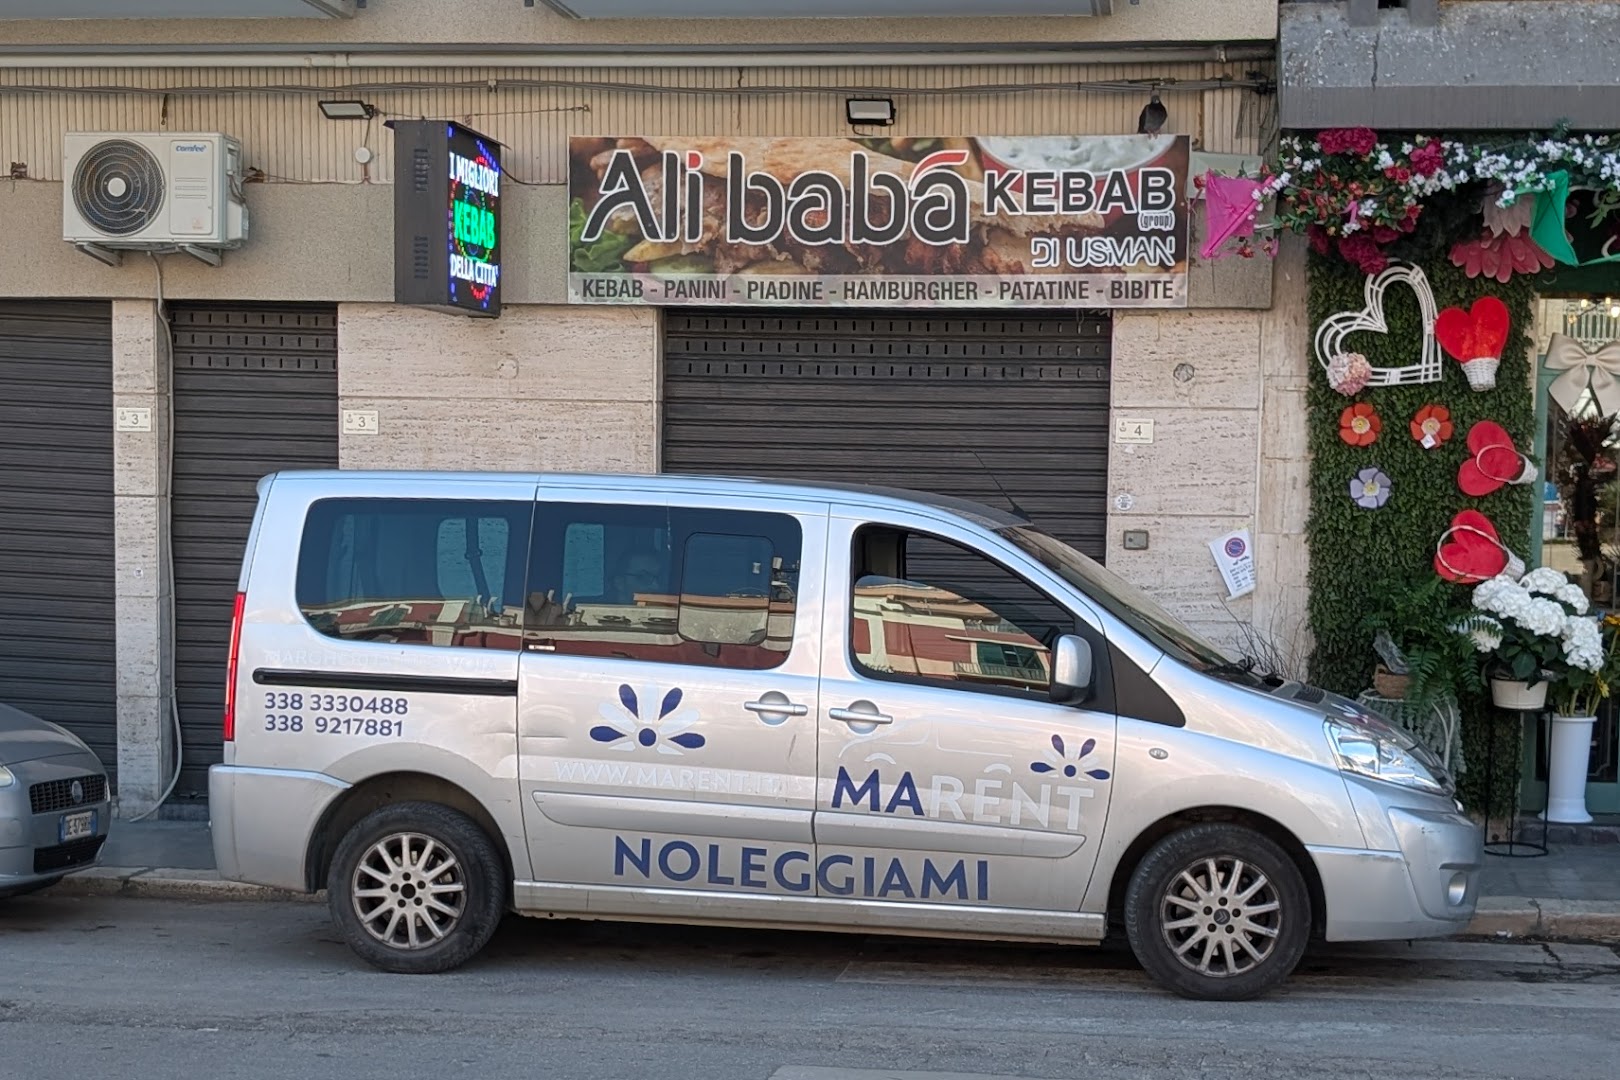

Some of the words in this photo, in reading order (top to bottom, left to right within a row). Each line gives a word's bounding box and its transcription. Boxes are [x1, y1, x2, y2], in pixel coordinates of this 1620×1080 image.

[449, 152, 455, 180] I
[456, 155, 499, 197] MIGLIORI
[580, 150, 703, 243] Ali
[984, 168, 1175, 214] KEBAB
[453, 200, 496, 249] KEBAB
[1032, 236, 1060, 267] DI
[1066, 236, 1175, 267] USMAN
[450, 253, 474, 281] DELLA
[583, 279, 643, 298] KEBAB
[664, 280, 726, 299] PANINI
[747, 281, 823, 300] PIADINE
[843, 281, 978, 301] HAMBURGHER
[1000, 281, 1090, 300] PATATINE
[1111, 280, 1173, 299] BIBITE
[131, 413, 139, 425] 3
[358, 416, 366, 428] 3
[1134, 424, 1142, 436] 4
[265, 692, 303, 710] 338
[310, 694, 408, 715] 3330488
[265, 714, 303, 732] 338
[315, 717, 403, 737] 9217881
[614, 835, 988, 900] NOLEGGIAMI
